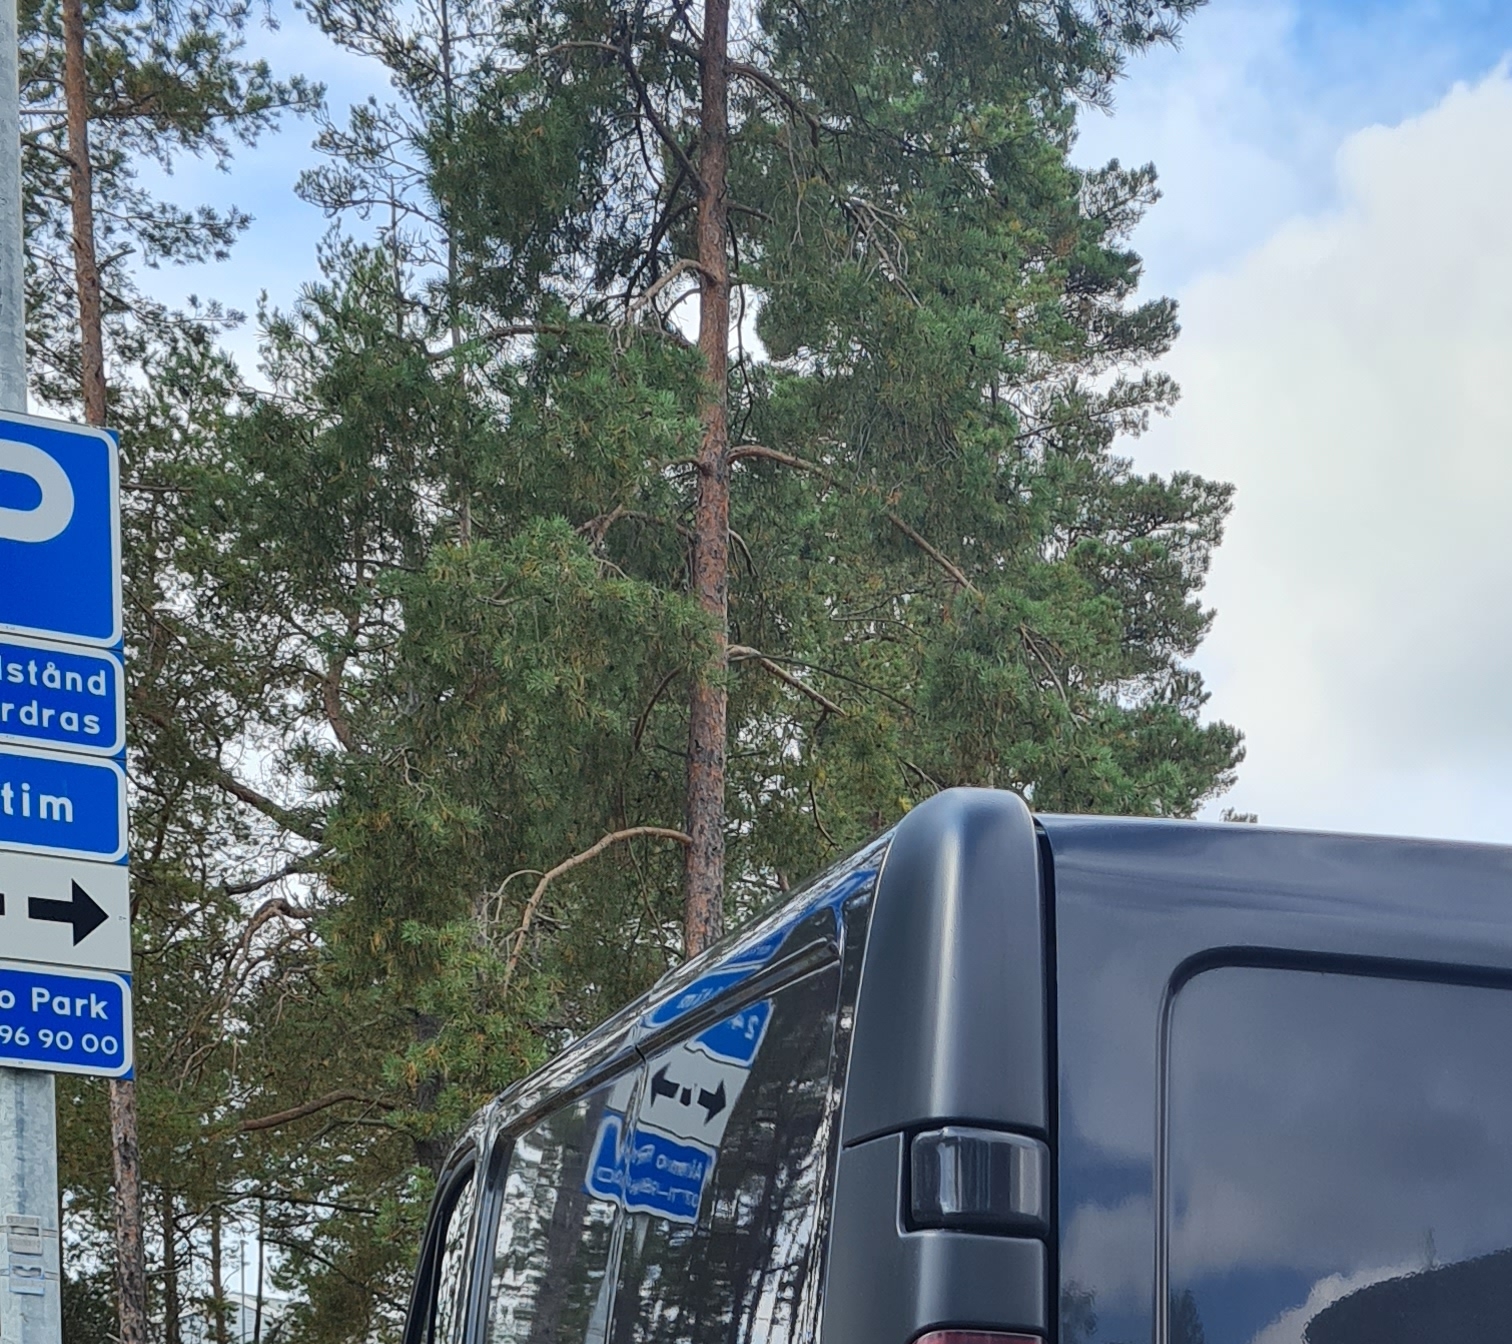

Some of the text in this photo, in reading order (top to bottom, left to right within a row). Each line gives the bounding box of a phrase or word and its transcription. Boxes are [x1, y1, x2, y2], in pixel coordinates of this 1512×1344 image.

[1, 699, 101, 735] rdras
[1, 781, 74, 823] tim
[31, 986, 109, 1020] Park
[0, 1024, 118, 1055] 96 90 00
